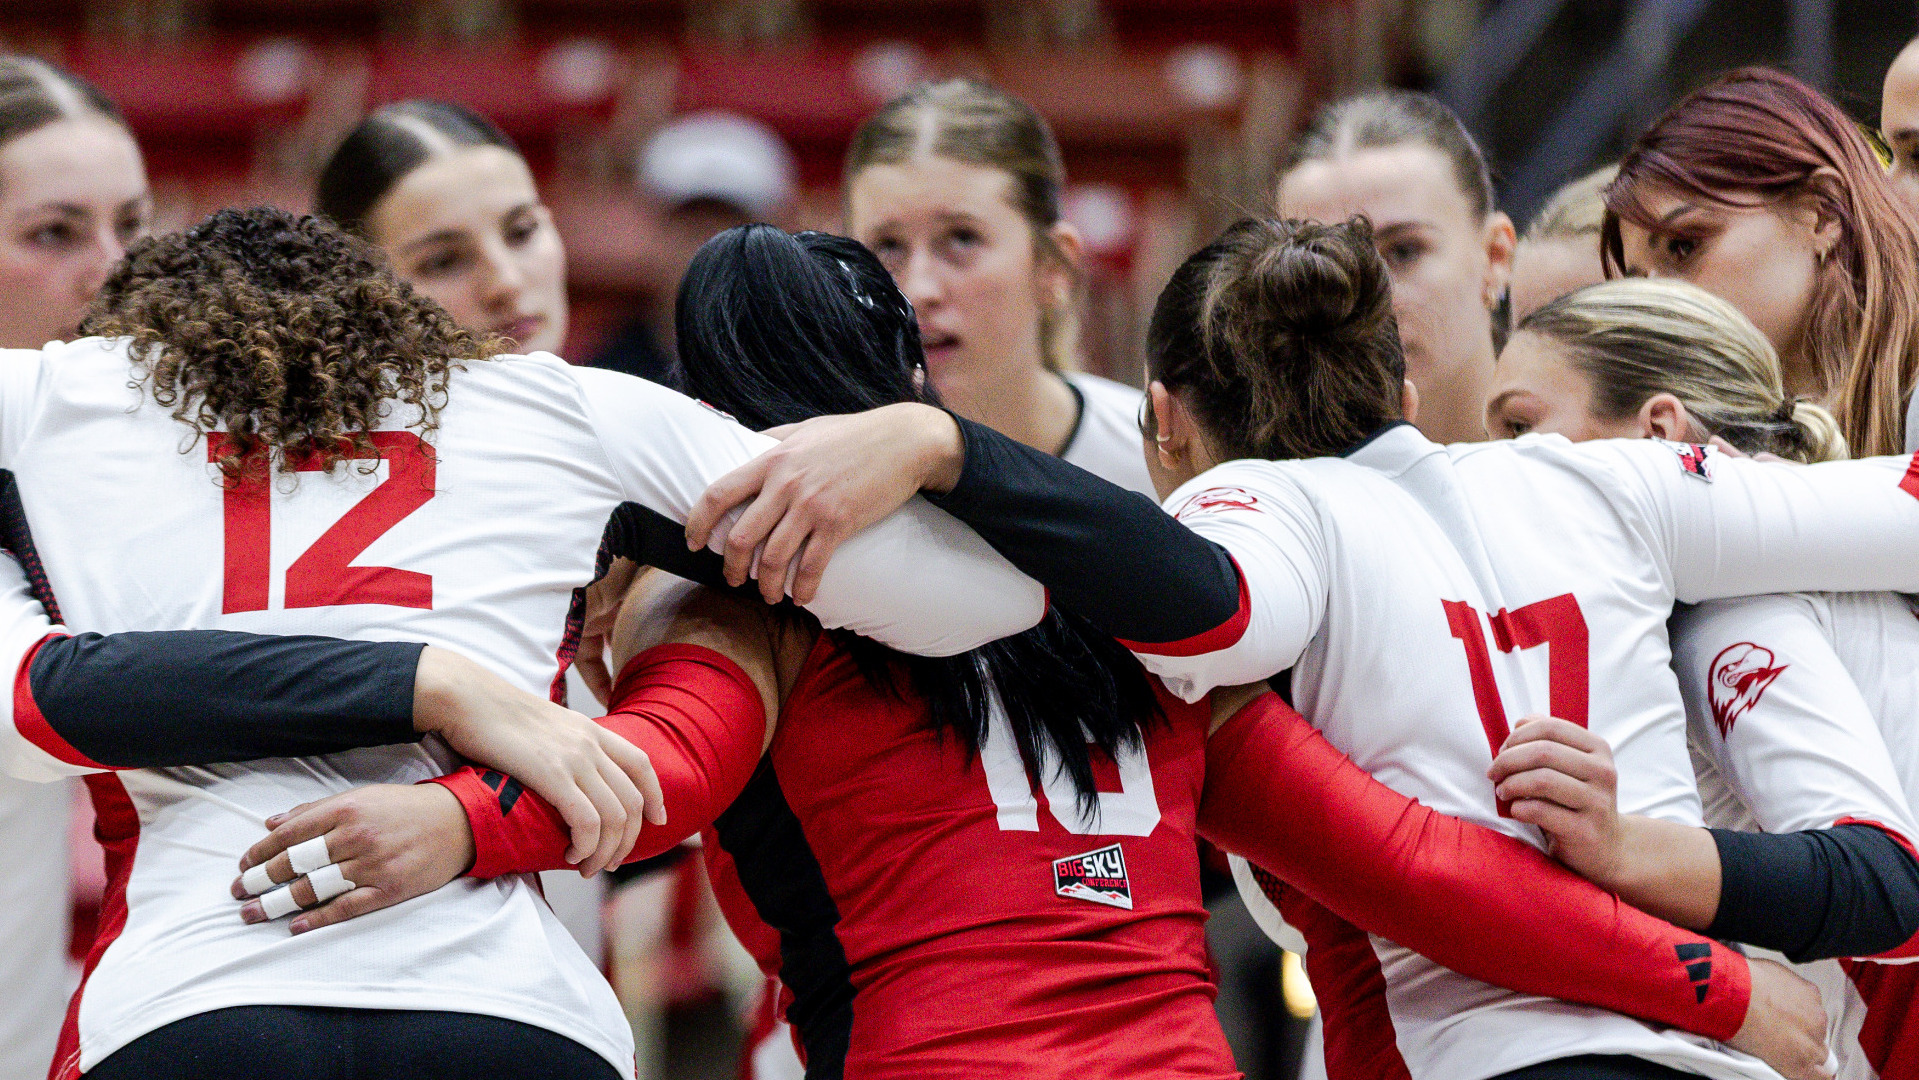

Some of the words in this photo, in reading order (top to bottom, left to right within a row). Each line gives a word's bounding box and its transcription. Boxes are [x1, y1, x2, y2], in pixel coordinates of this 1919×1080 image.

[207, 431, 437, 615] 12
[1440, 592, 1590, 818] 17
[1081, 878, 1128, 888] CONFERENCE
